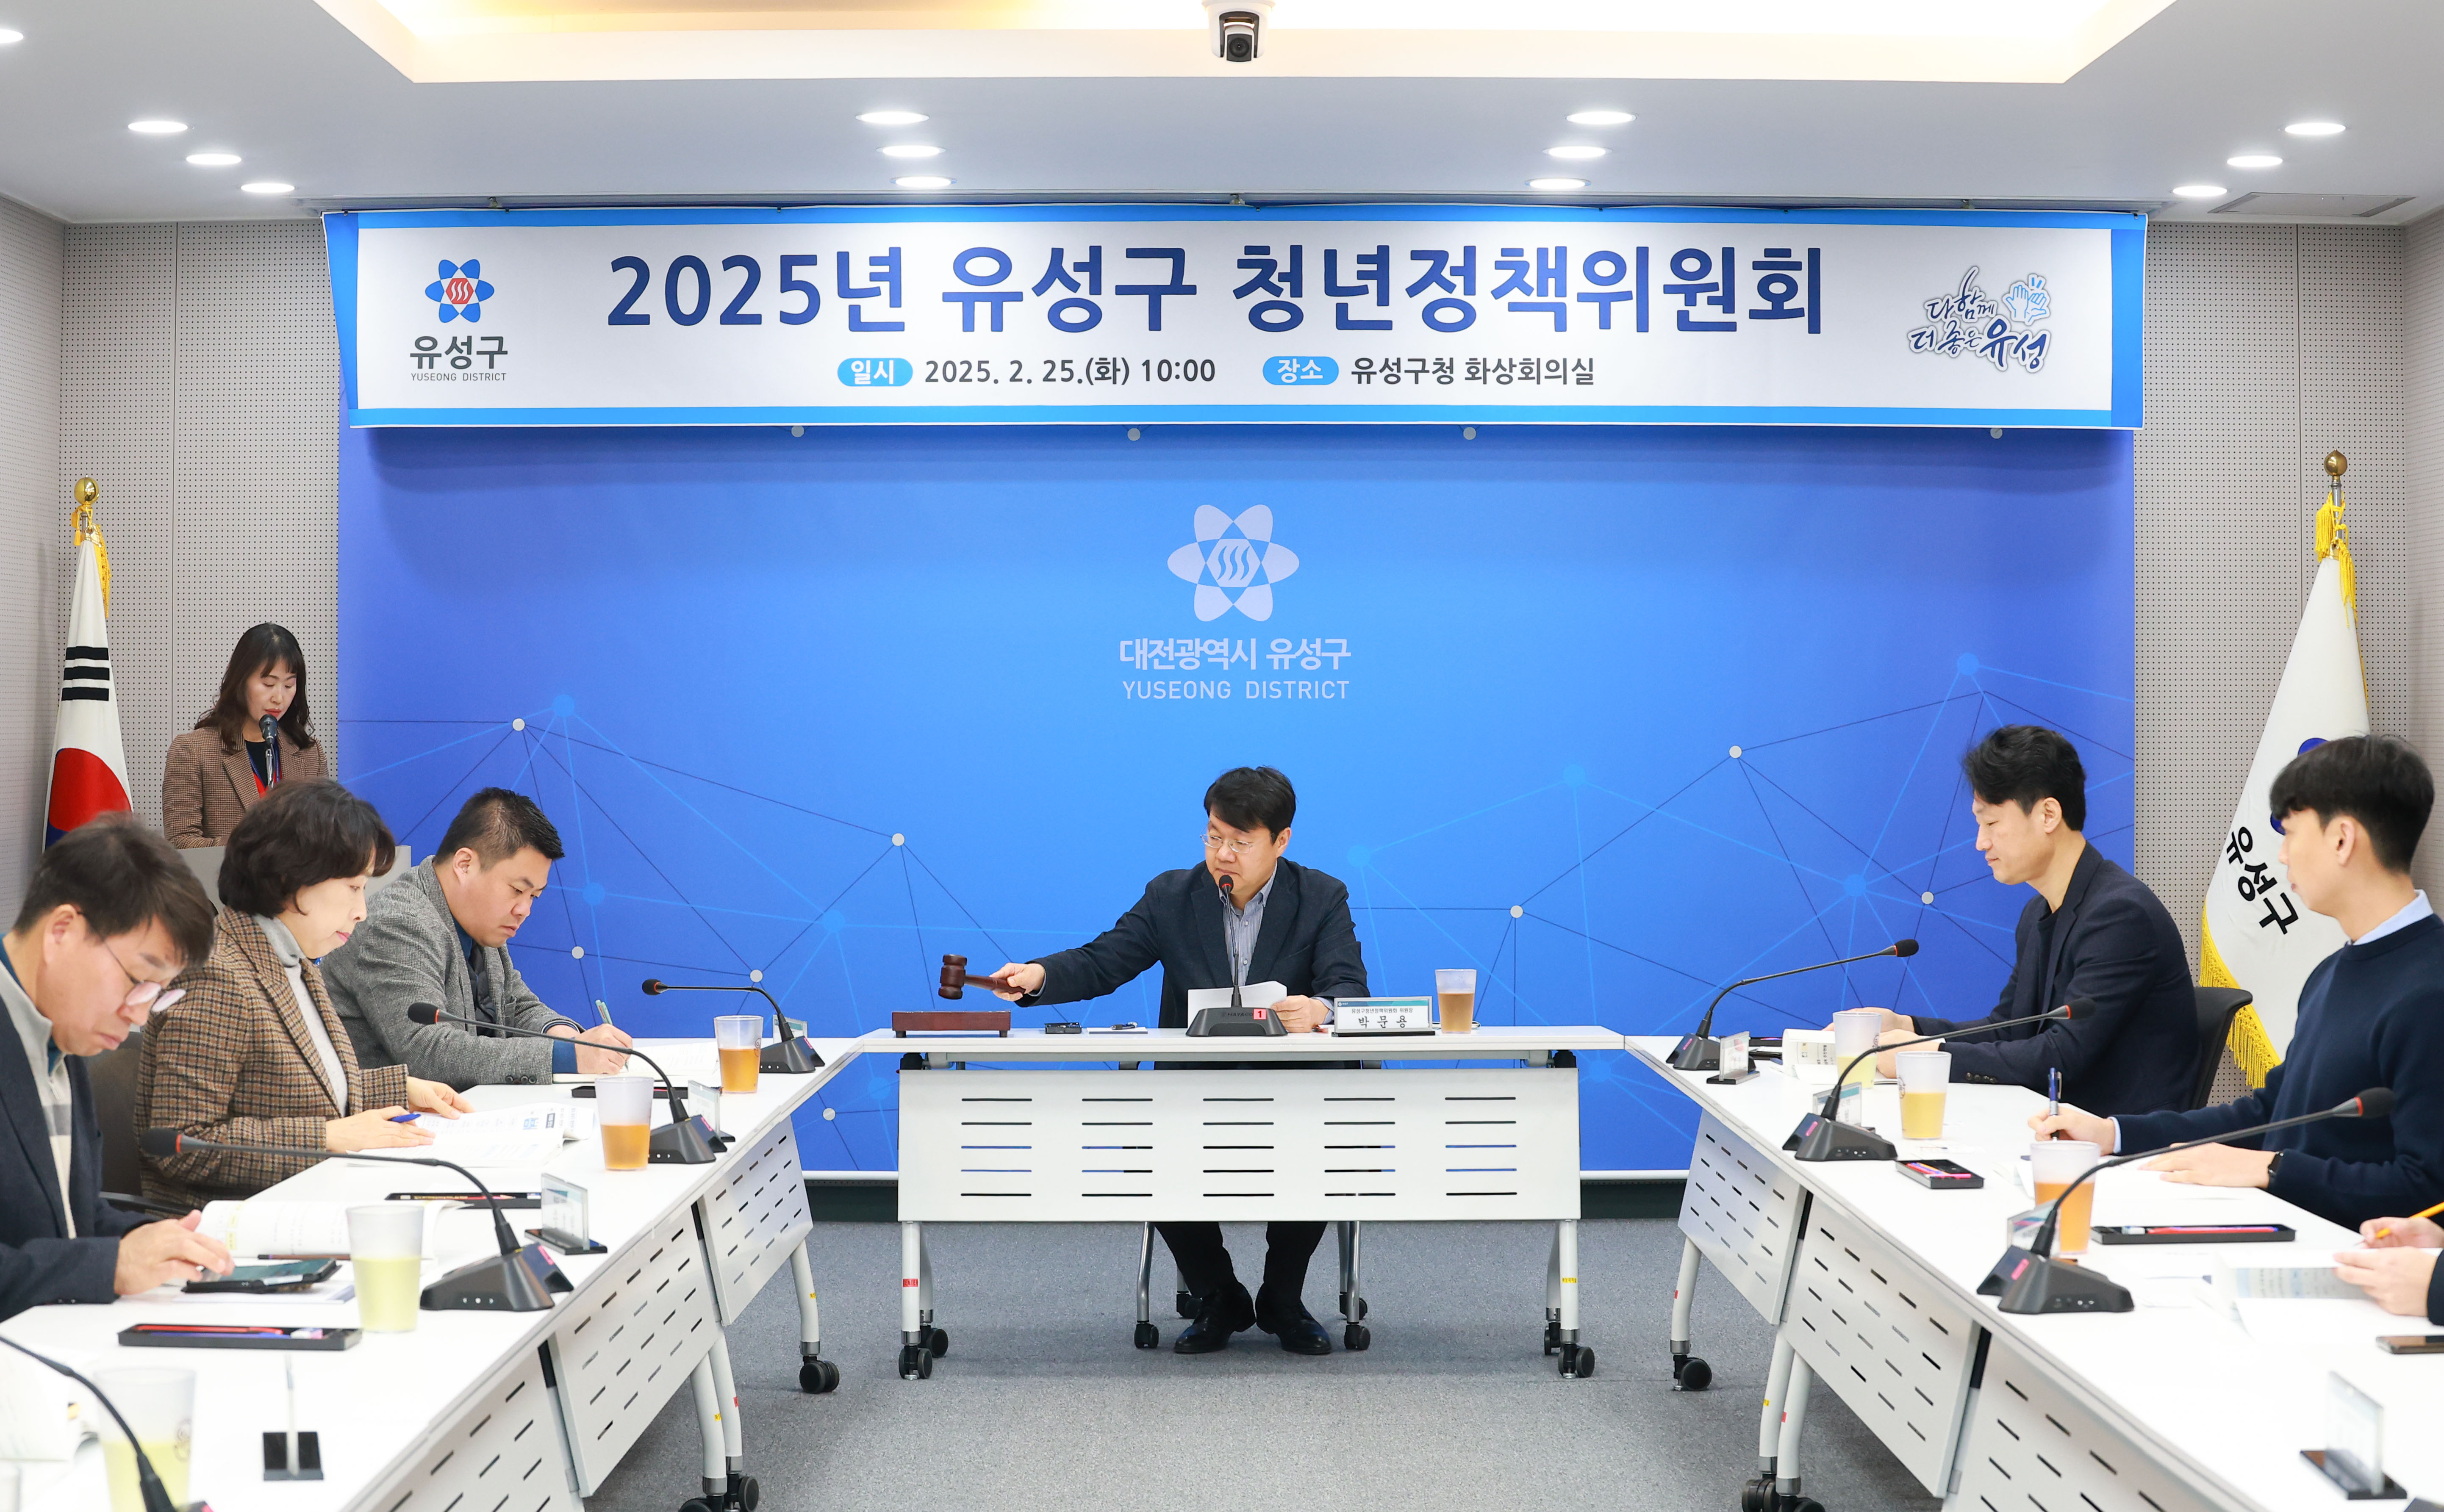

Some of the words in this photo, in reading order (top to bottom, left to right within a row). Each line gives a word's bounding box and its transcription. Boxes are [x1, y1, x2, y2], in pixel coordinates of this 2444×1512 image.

[608, 247, 905, 332] 2025년
[942, 245, 1197, 333] 유성구
[1232, 244, 1821, 334] 청년정책위원회
[410, 335, 508, 370] 유성구
[411, 373, 457, 381] YUSEONG
[462, 373, 507, 381] DISTRICT
[851, 360, 894, 384] 일시
[925, 360, 999, 384] 2025.
[1010, 360, 1032, 384] 2.
[1043, 357, 1129, 385] 25.(화)
[1142, 359, 1215, 382] 10:00
[1277, 359, 1324, 383] 장소
[1351, 357, 1454, 385] 유성구청
[1465, 358, 1593, 385] 화상회의실
[1120, 638, 1256, 670] 대전광역시
[1266, 638, 1351, 670] 유성구
[1122, 681, 1231, 699] YUSEONG
[1246, 681, 1350, 699] DISTRICT
[2226, 826, 2299, 934] 유성구
